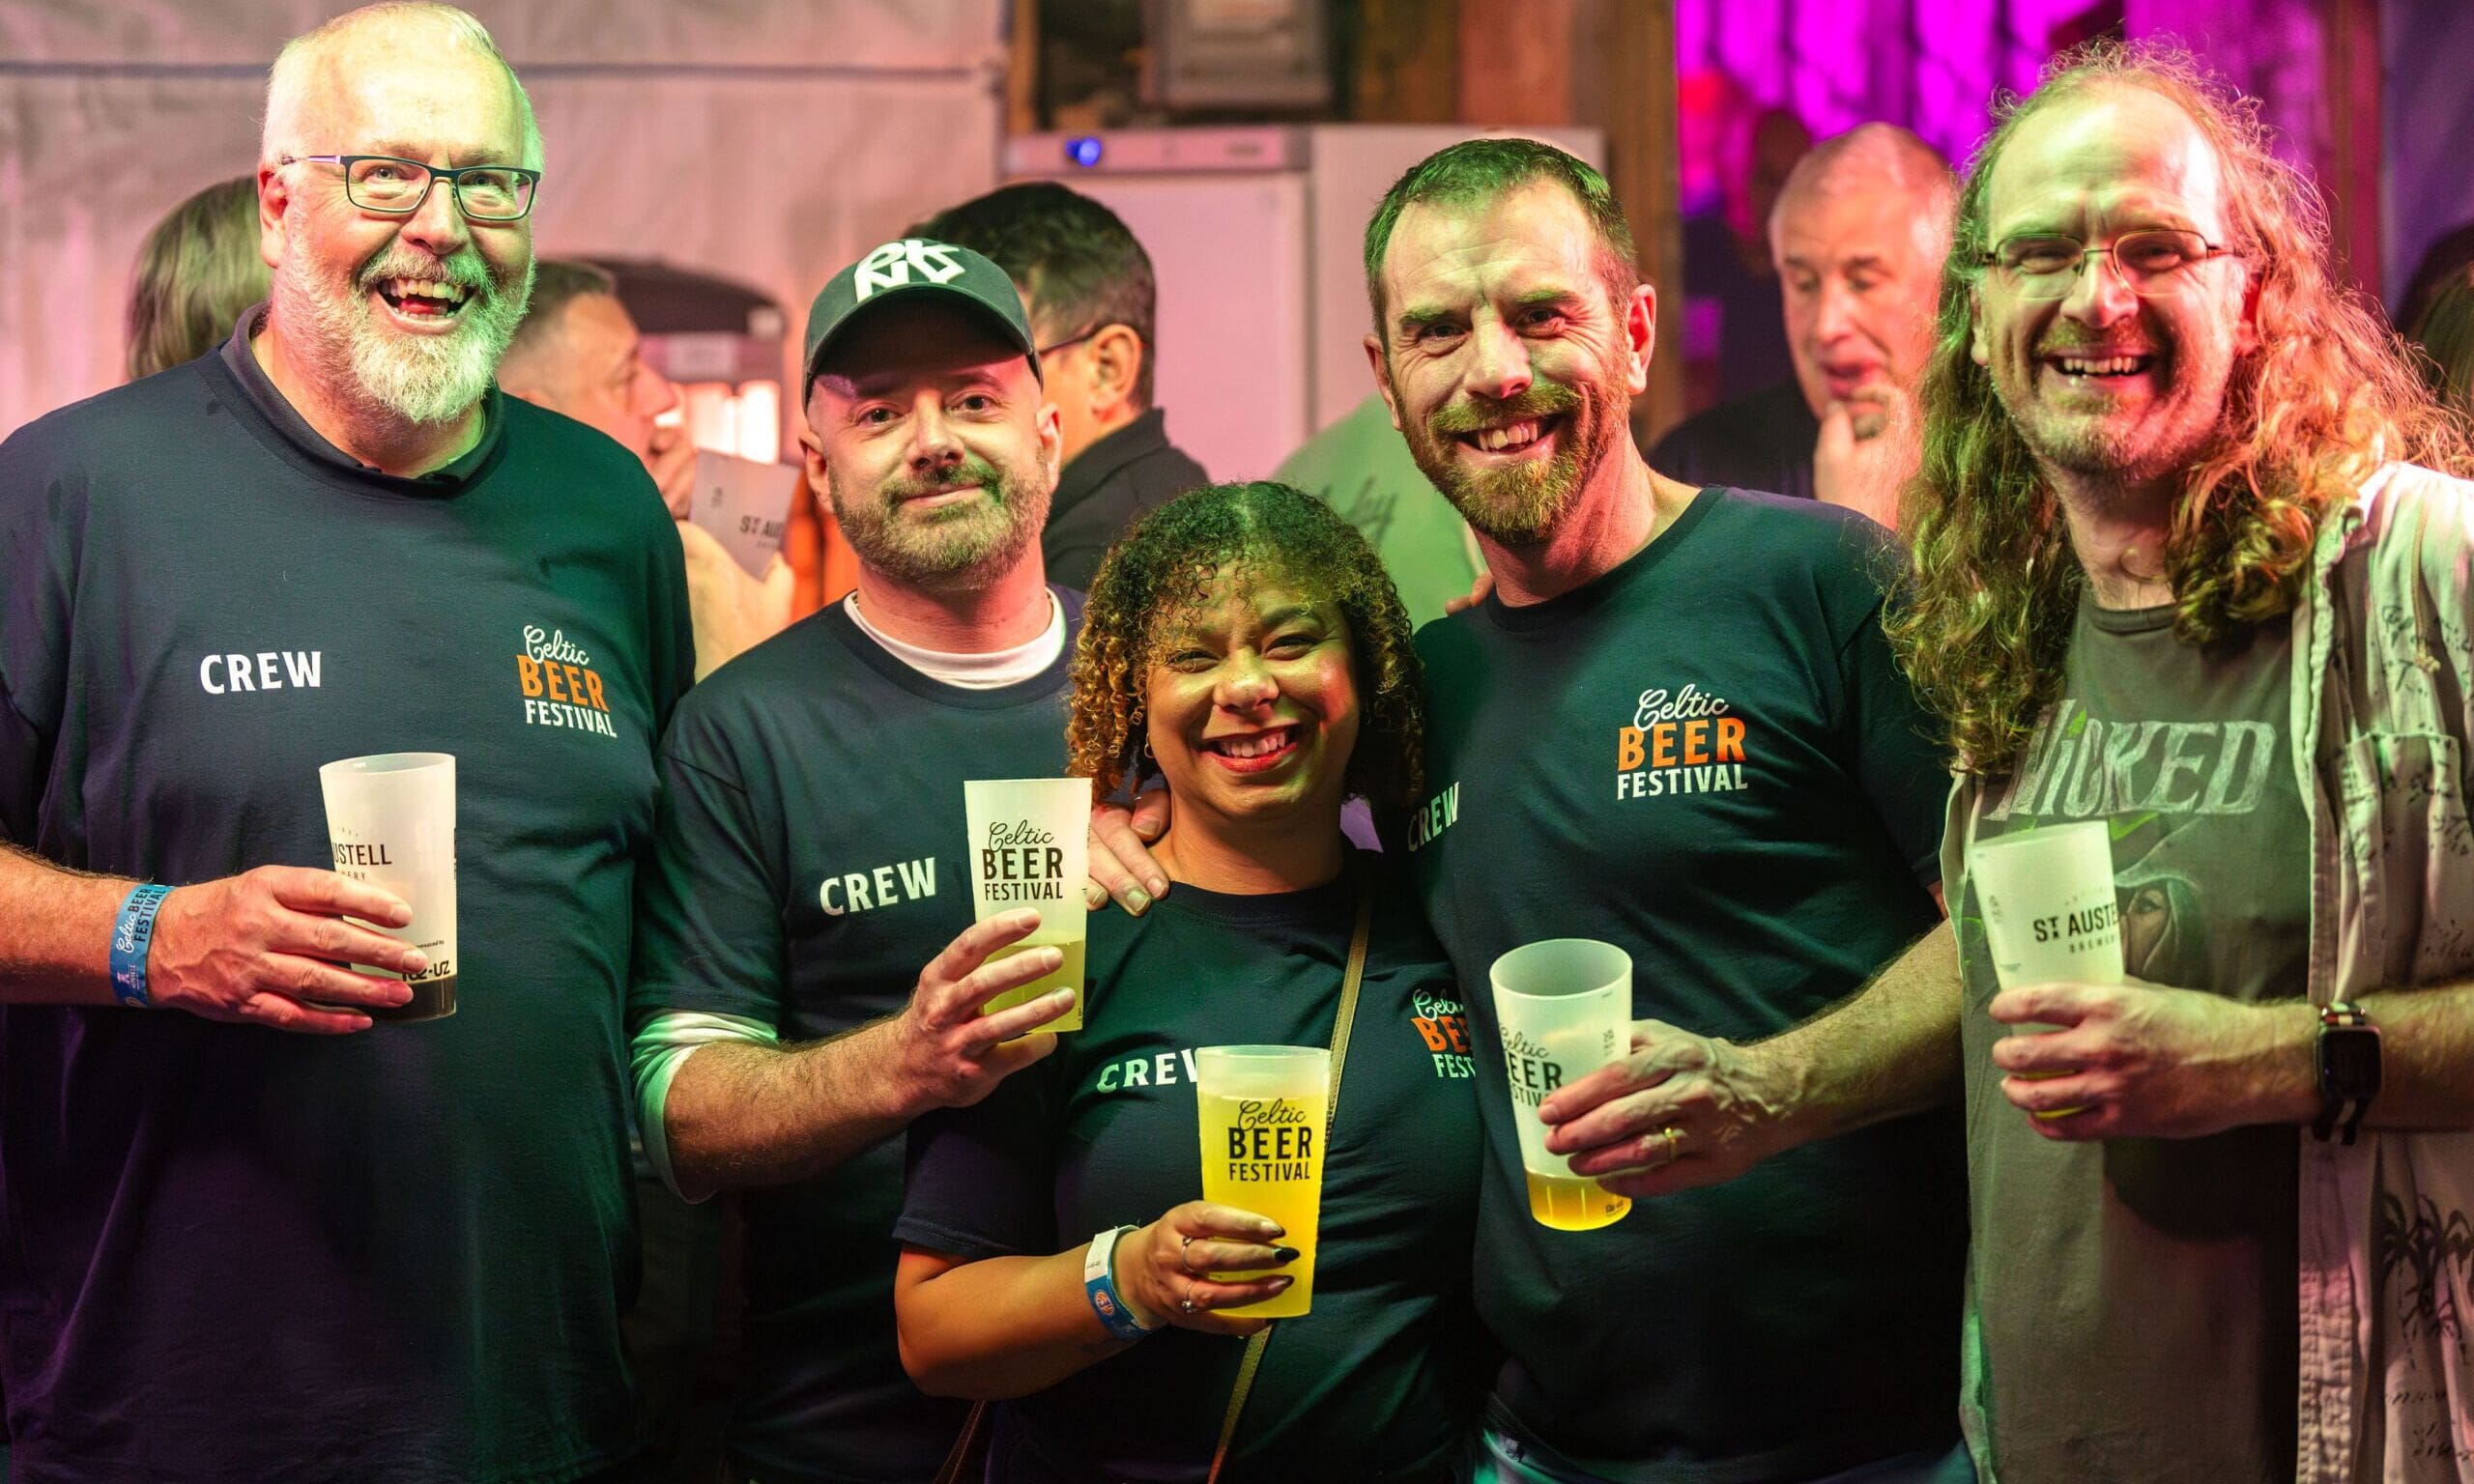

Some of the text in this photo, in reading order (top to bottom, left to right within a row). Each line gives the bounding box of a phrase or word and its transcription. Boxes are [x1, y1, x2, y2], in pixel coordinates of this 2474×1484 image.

[523, 624, 590, 665] Celtic
[199, 650, 322, 695] CREW
[516, 654, 611, 713] BEER
[524, 699, 618, 738] FESTIVAL
[1633, 683, 1730, 732] Celtic
[1618, 717, 1747, 772] BEER
[1617, 763, 1748, 801] FESTIVAL
[989, 819, 1054, 852] Celtic
[1407, 781, 1460, 852] CREW
[982, 847, 1063, 880] BEER
[820, 857, 936, 917] CREW
[985, 881, 1063, 900] FESTIVAL
[116, 888, 150, 953] Celtic BEER
[133, 889, 166, 943] FESTIVAL
[1238, 1098, 1307, 1131] Celtic
[1228, 1127, 1312, 1160] BEER
[1228, 1161, 1310, 1182] FESTIVAL
